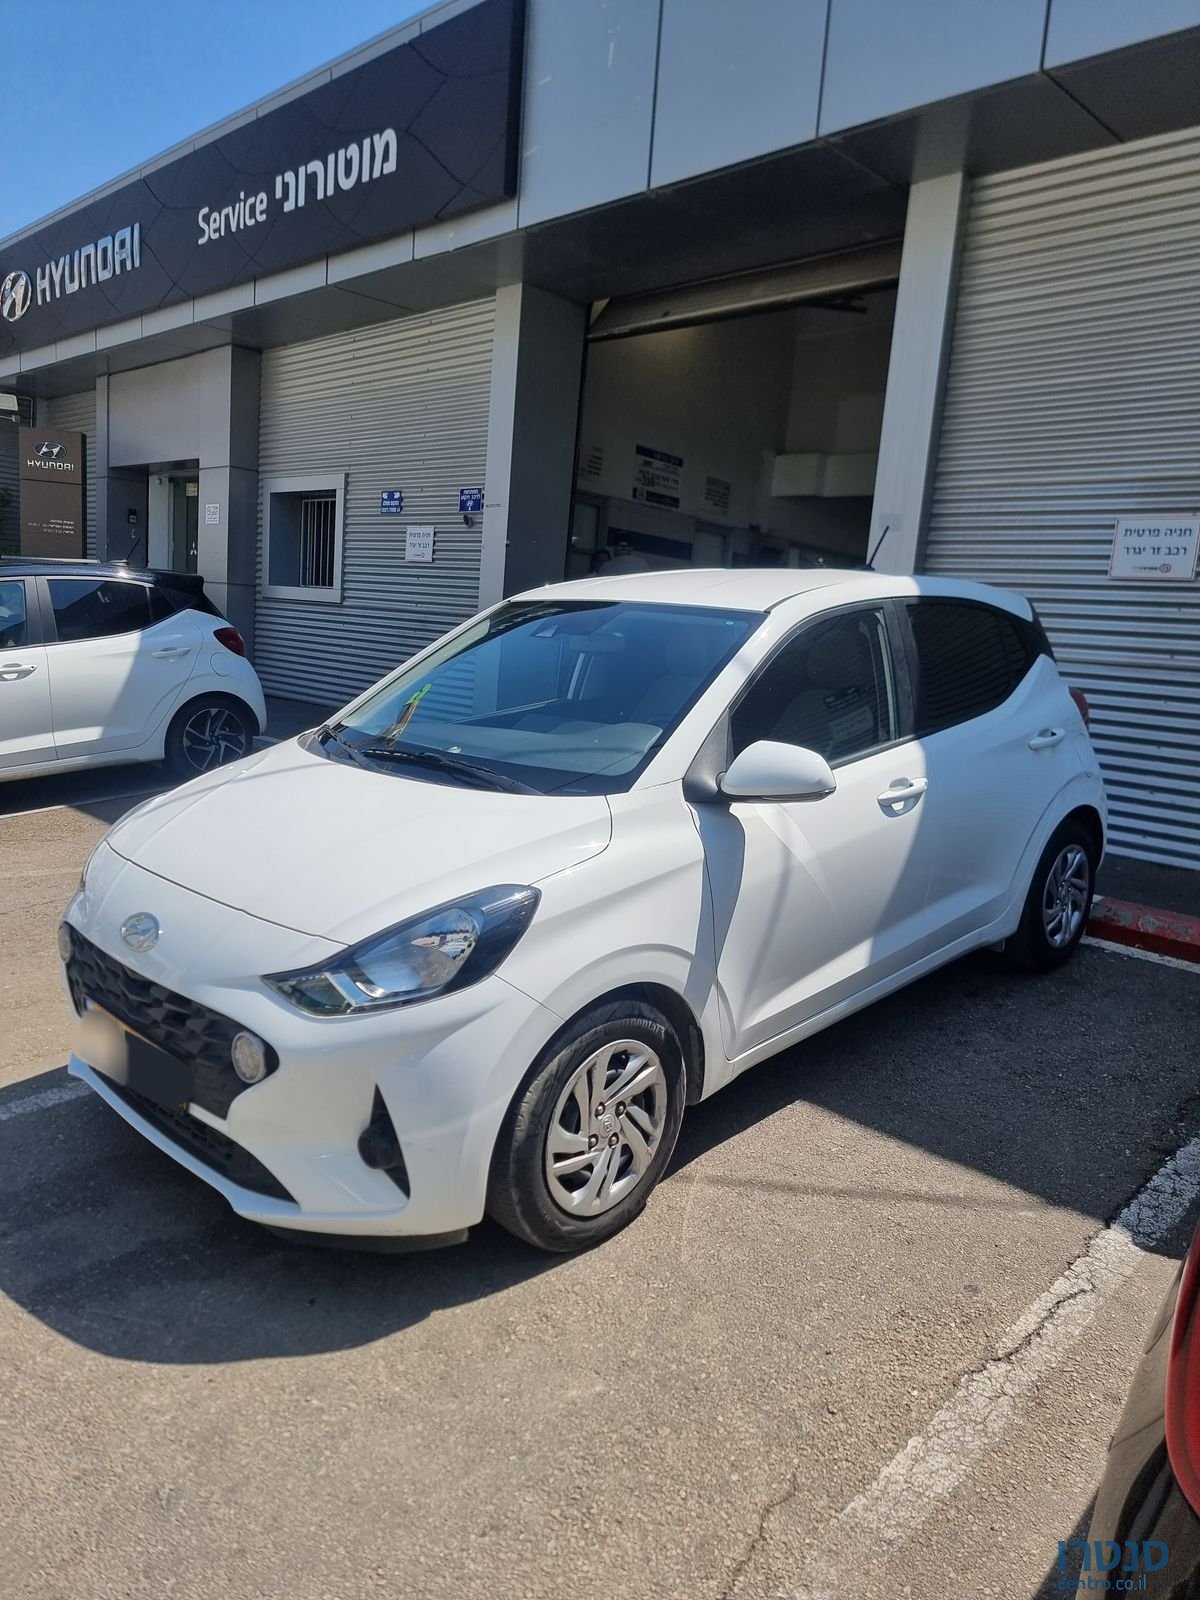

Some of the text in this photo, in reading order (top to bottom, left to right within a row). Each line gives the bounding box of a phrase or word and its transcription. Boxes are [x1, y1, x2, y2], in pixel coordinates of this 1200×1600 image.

[275, 127, 399, 213] מוטורוני
[197, 190, 267, 245] Service
[36, 222, 141, 306] HYUNDAI
[27, 459, 74, 471] HYUNDAI
[1123, 527, 1193, 538] חניה פרטית
[1149, 546, 1162, 556] זר
[1164, 546, 1188, 556] רכב
